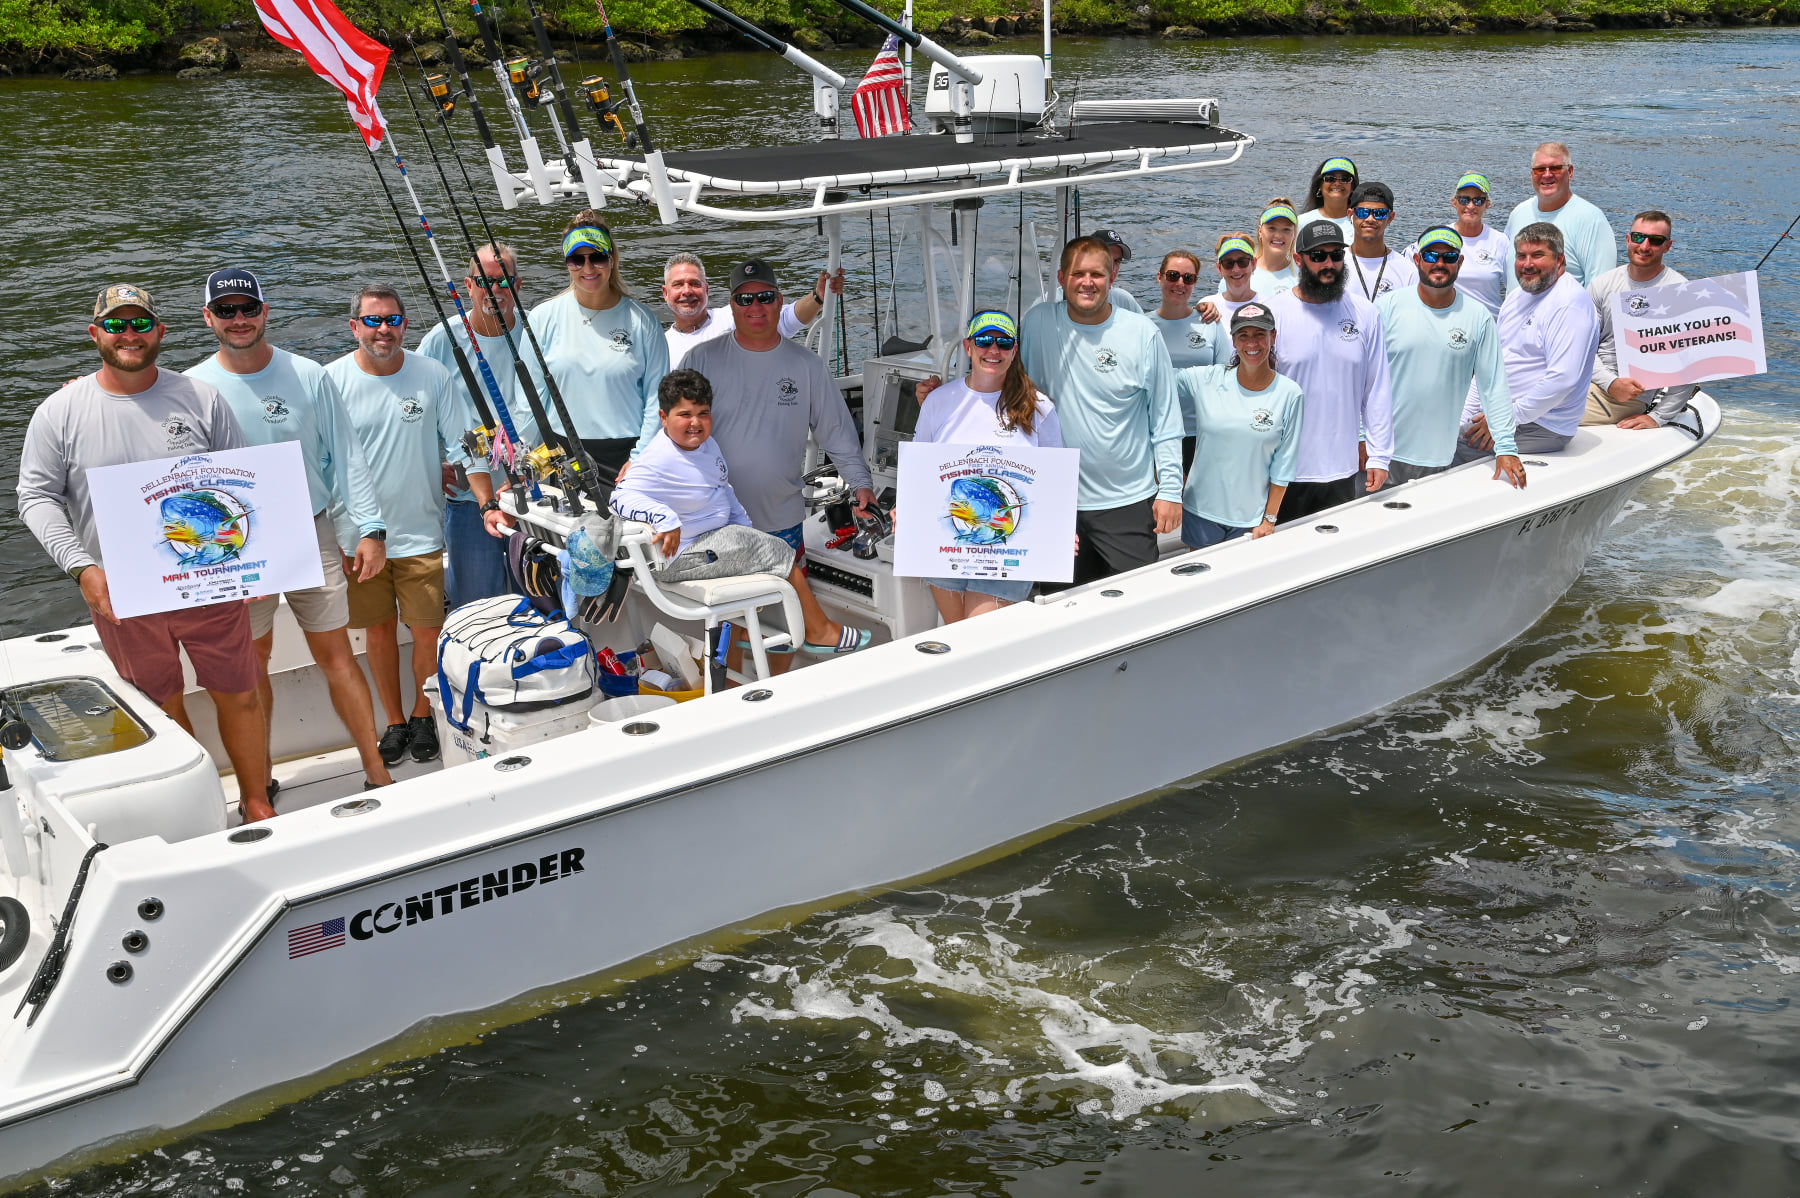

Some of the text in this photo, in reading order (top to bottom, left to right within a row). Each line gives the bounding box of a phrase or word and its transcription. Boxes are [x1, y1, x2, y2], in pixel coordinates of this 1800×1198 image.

[216, 279, 252, 288] SMITH
[1637, 316, 1731, 338] THANK YOU TO
[1640, 330, 1737, 354] OUR VETERANS!
[938, 458, 1036, 476] DELLENBACH FOUNDATION
[940, 468, 1034, 485] FISHING CLASSIC
[140, 468, 256, 494] DELLENBACH FOUNDATION
[144, 479, 256, 504] FISHING CLASSIC
[1518, 518, 1536, 536] FL
[966, 546, 1029, 556] TOURNAMENT
[162, 572, 190, 584] MAHI
[194, 560, 268, 578] TOURNAMENT
[349, 847, 586, 941] CONTENDER
